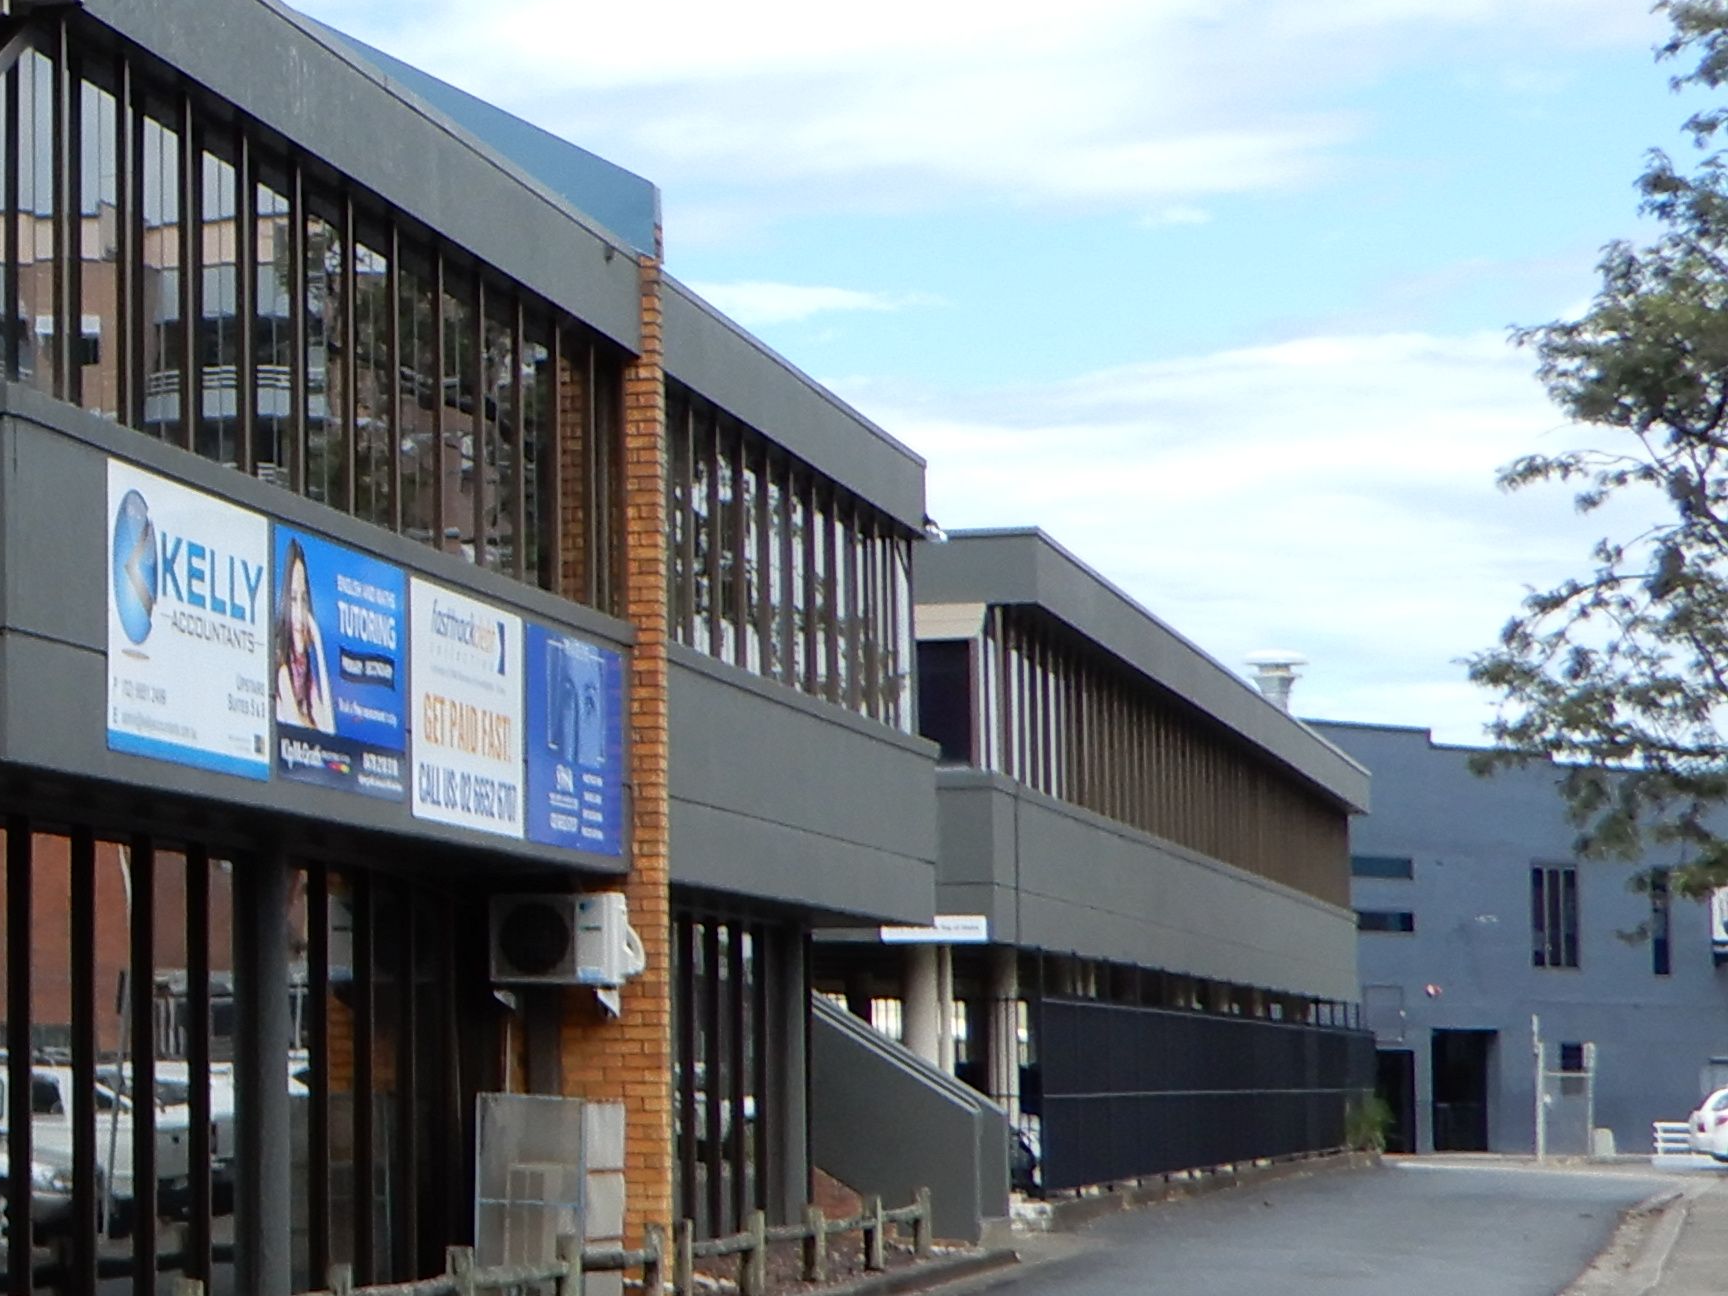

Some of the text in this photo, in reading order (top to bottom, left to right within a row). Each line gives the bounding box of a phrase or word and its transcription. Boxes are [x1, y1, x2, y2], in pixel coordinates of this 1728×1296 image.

[161, 530, 264, 625] KELLY
[171, 610, 256, 654] ACCOUNTANTS
[337, 600, 397, 650] TUTORING
[423, 691, 445, 746] GET
[448, 699, 477, 754] PAID
[481, 709, 512, 762] FAST!
[418, 761, 441, 806] CALL
[459, 771, 472, 813] 02
